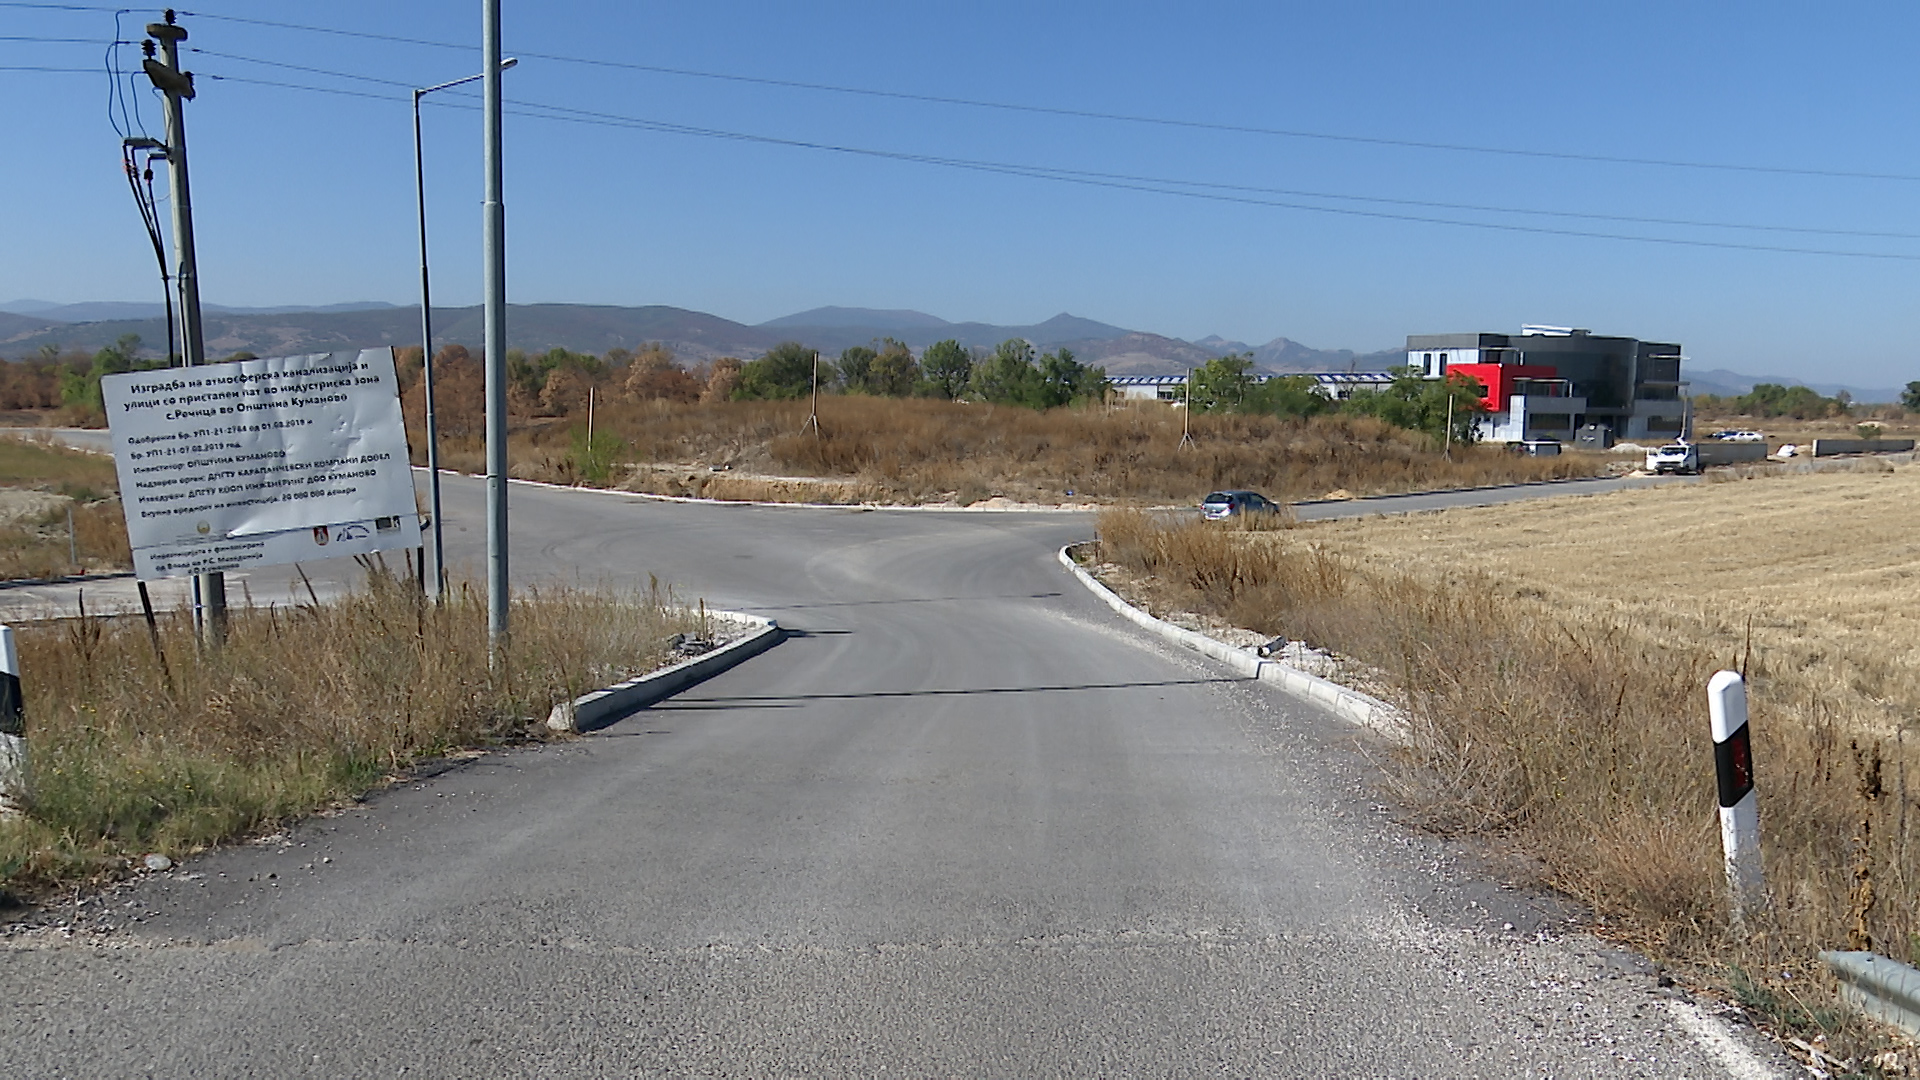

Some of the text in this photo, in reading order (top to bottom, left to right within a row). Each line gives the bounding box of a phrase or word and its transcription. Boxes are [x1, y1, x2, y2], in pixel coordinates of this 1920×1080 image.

[131, 361, 369, 394] Изградба на атмосферска канализација и
[123, 374, 381, 412] улици со пристапен пат во индустриска зона
[219, 406, 234, 415] во
[236, 400, 289, 412] Општина
[290, 394, 348, 407] Куманово
[249, 424, 260, 433] од
[187, 456, 234, 468] ОПШТИНА
[236, 449, 286, 462] КУМАНОВО
[314, 456, 358, 468] КОМПАНИ
[328, 469, 377, 481] КУМАНОВО
